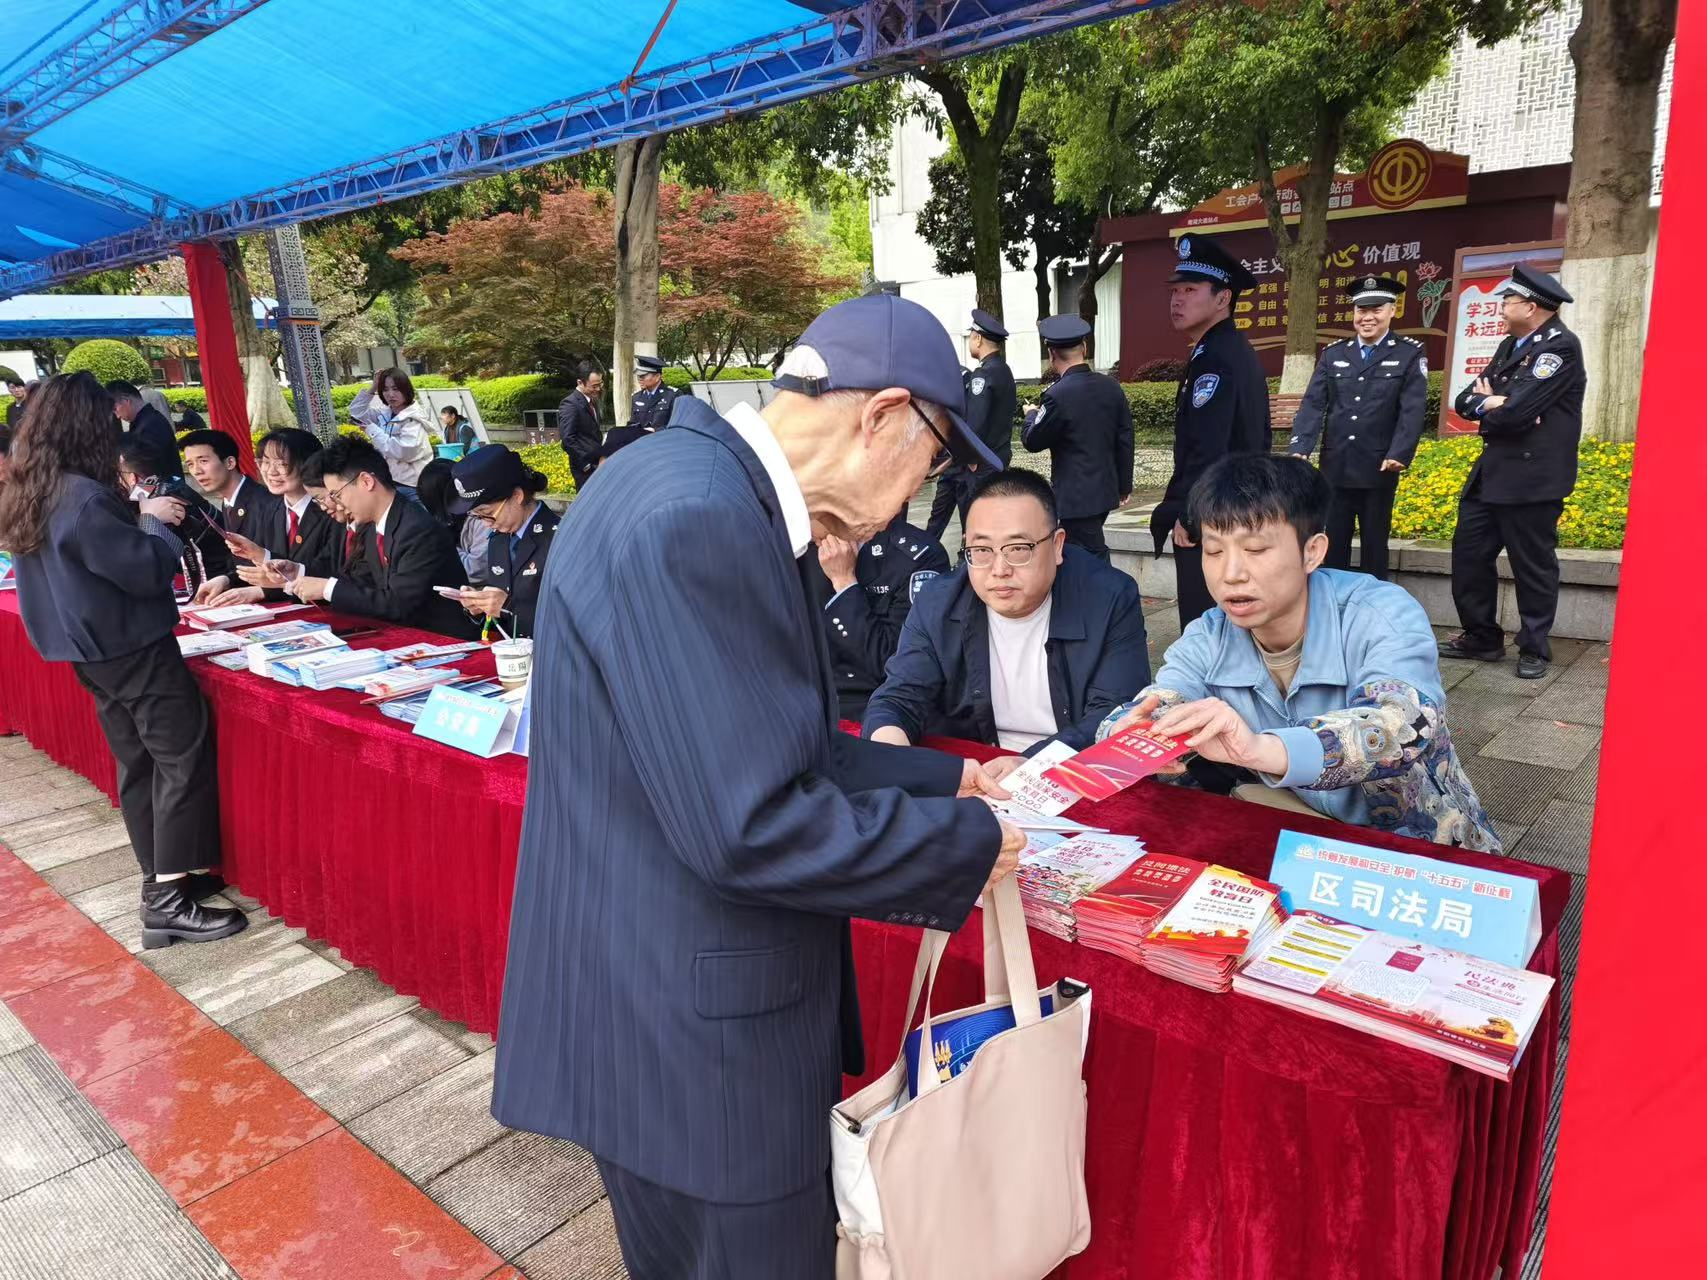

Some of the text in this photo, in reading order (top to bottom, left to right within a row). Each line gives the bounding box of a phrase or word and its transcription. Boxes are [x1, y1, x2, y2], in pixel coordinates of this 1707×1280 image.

[1363, 241, 1421, 265] 价值观
[1258, 283, 1278, 294] 富强
[1258, 299, 1277, 311] 自由
[1466, 302, 1503, 318] 学习
[1257, 315, 1277, 327] 爱国
[1208, 878, 1266, 898] 全民国防
[1393, 864, 1417, 880] 护航
[1472, 882, 1513, 900] 新征程
[1308, 871, 1473, 938] 区司法局
